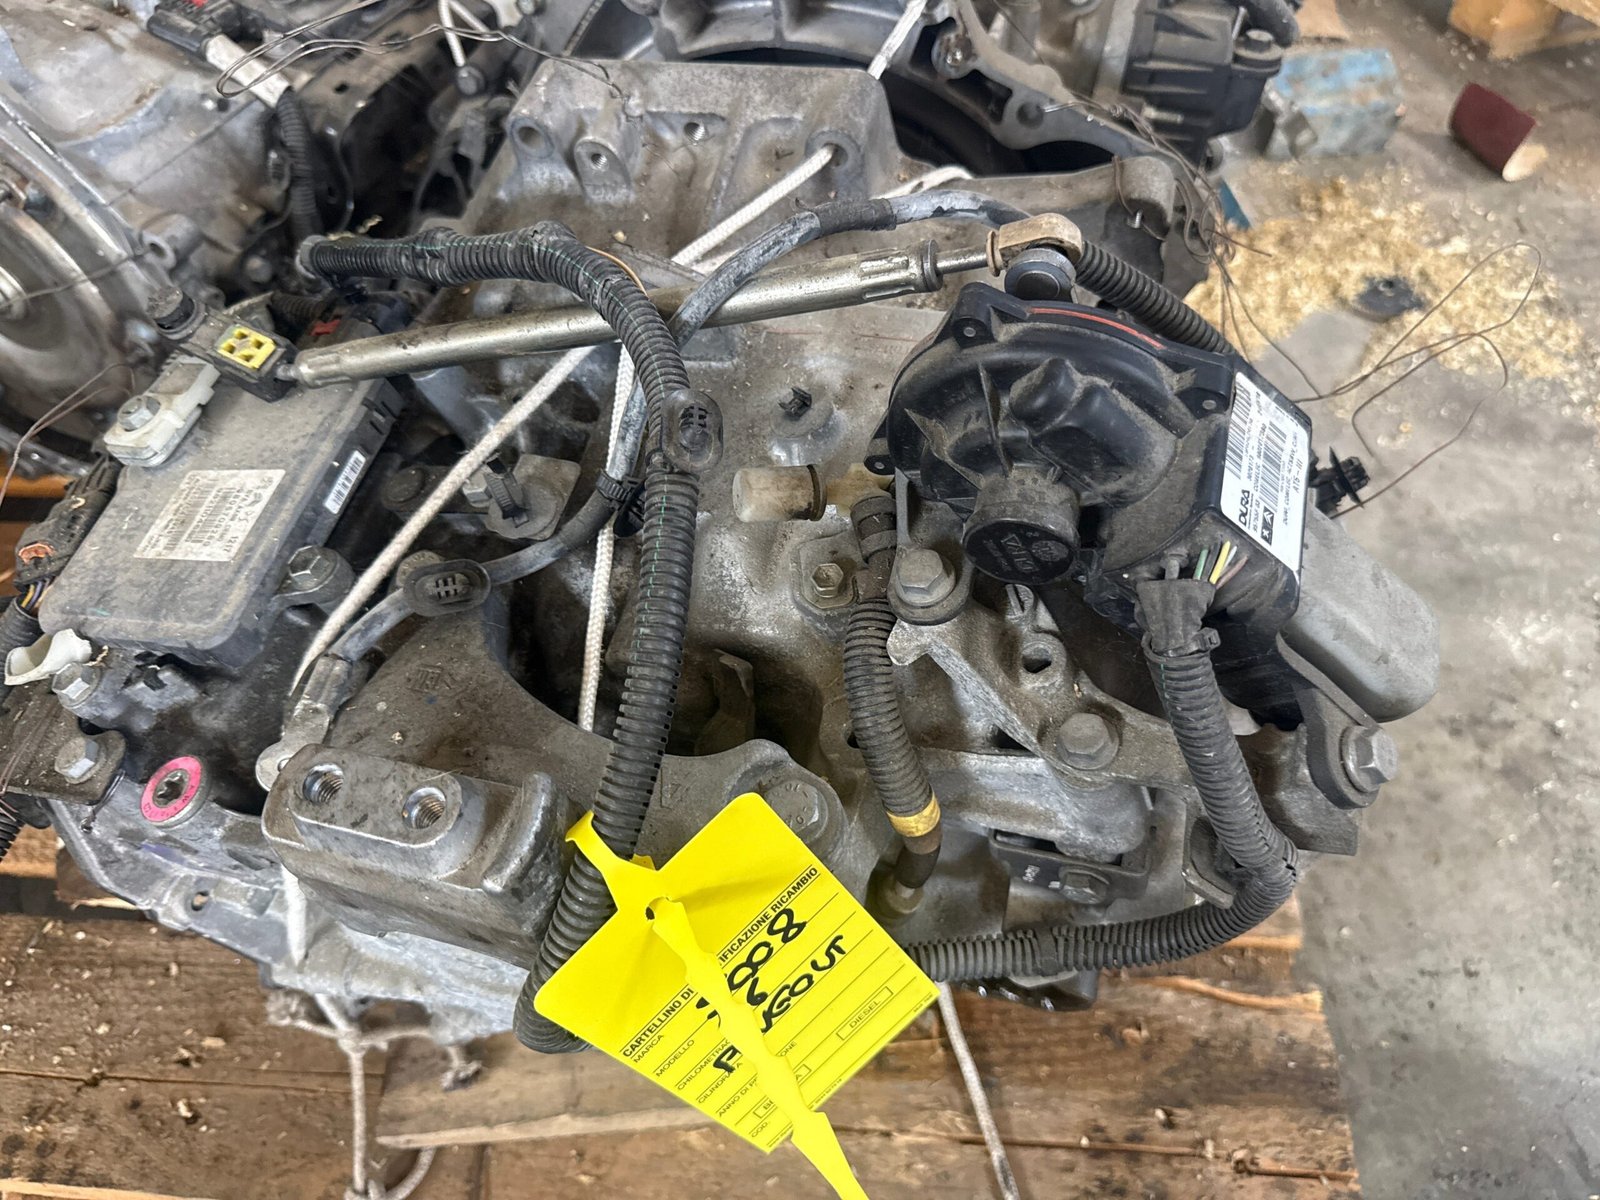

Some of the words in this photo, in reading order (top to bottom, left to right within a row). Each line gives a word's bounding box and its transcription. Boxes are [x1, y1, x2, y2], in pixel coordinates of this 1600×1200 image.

[1238, 488, 1250, 527] DURA
[622, 1000, 682, 1057] CARTELLINO
[681, 987, 694, 1000] DI
[719, 911, 772, 964] IFICAZIONE
[770, 867, 818, 913] RICAMBIO
[849, 1000, 880, 1029] DIESEL
[633, 1034, 664, 1063] MARCA
[656, 1039, 695, 1077] MODELLO
[698, 1062, 743, 1103] CILINDRA
[718, 1095, 741, 1117] ANNO
[740, 1087, 750, 1096] DI
